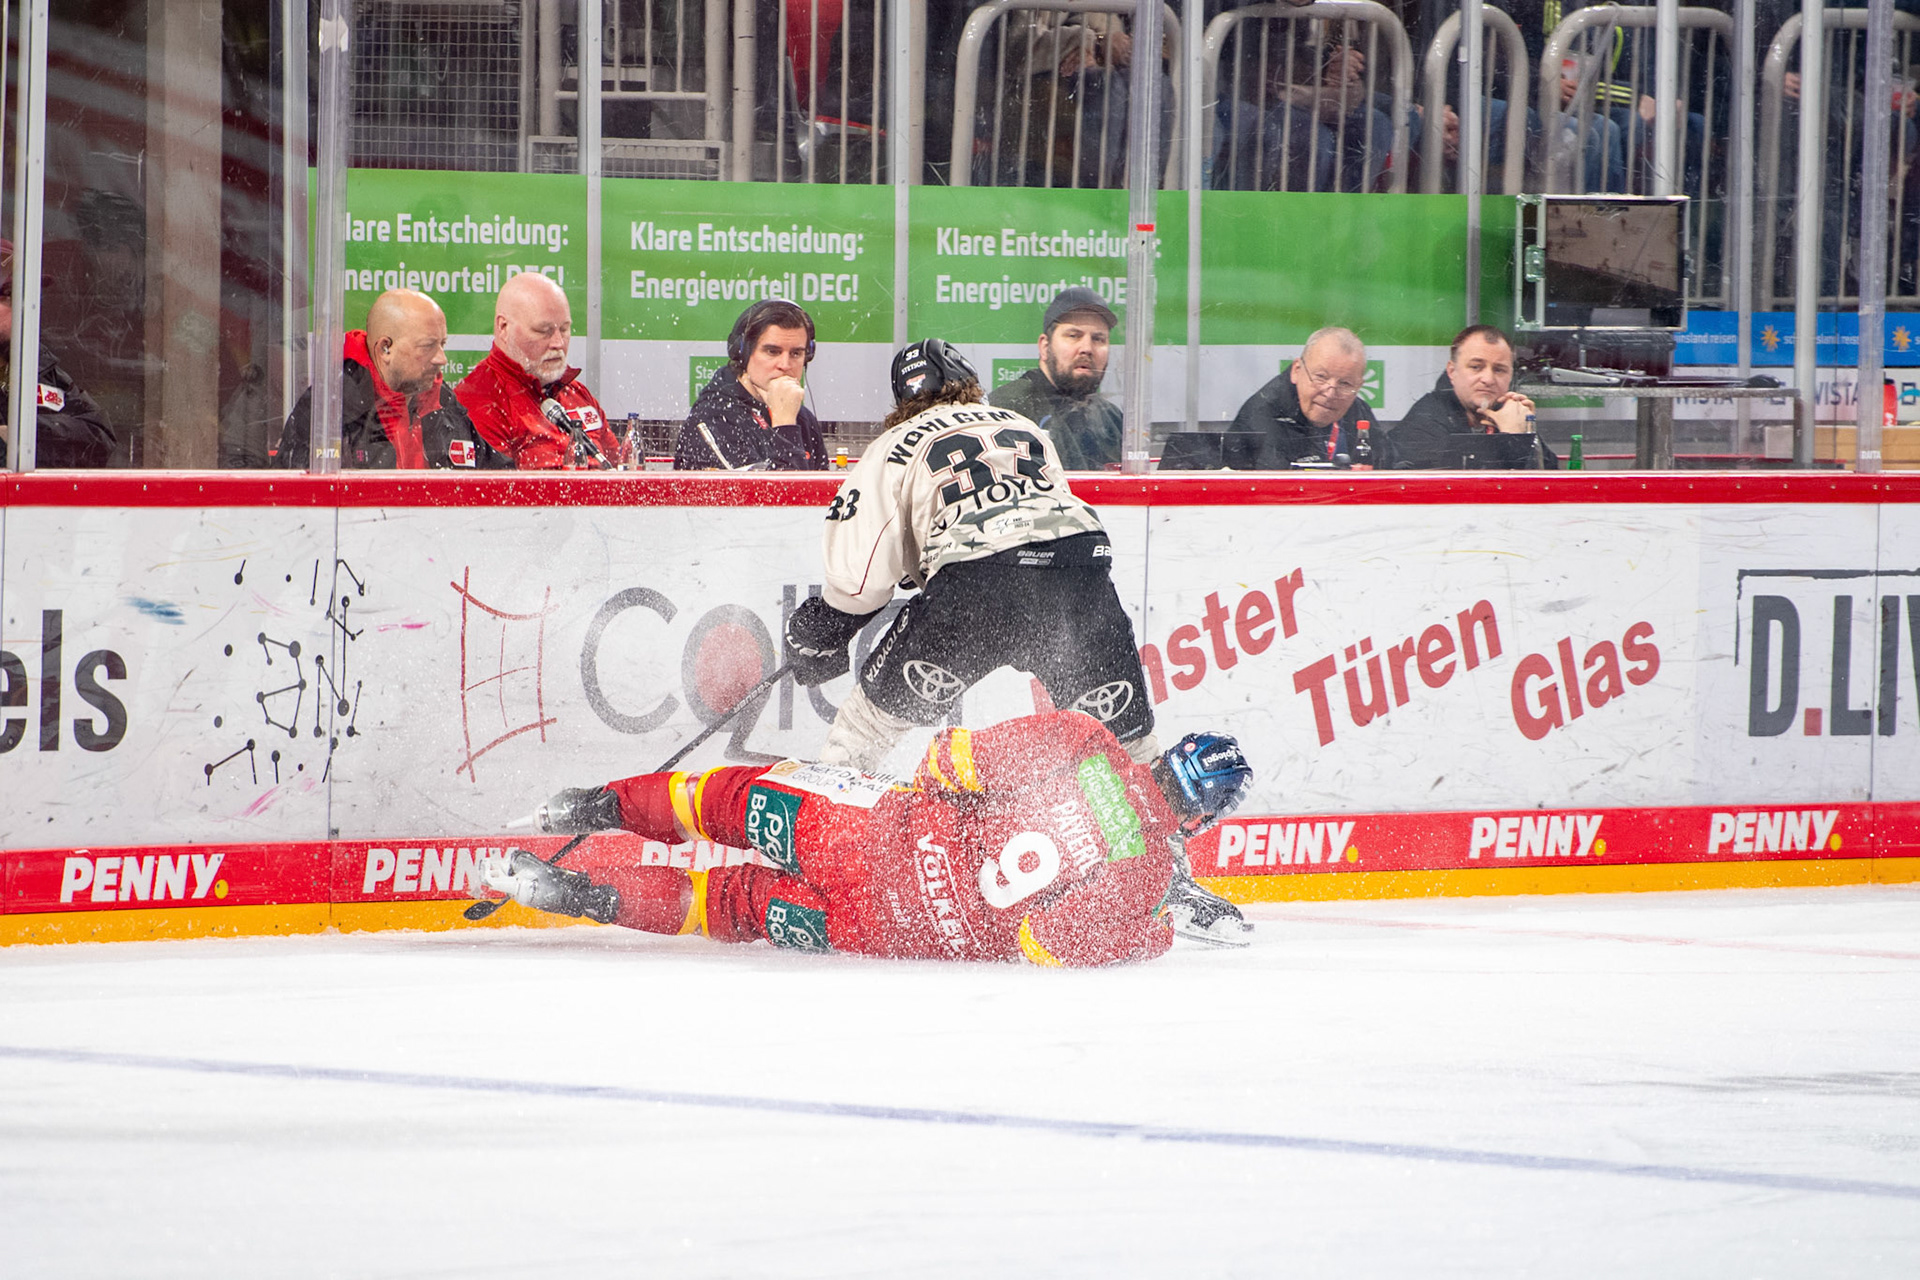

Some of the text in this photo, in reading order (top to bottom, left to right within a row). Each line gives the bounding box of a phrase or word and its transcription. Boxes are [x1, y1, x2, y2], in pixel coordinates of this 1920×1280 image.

[345, 212, 569, 253] lare Entscheidung:
[631, 221, 864, 261] Klare Entscheidung:
[936, 227, 996, 256] Klare
[345, 262, 499, 293] nergievorteil
[631, 270, 859, 307] Energievorteil DEG!
[901, 360, 928, 375] STETSON
[905, 349, 920, 362] 33
[887, 410, 1017, 467] WOHLGEM
[924, 427, 1050, 508] 33
[825, 488, 861, 522] 33
[965, 474, 1054, 510] TOYO
[865, 631, 898, 683] TOYOTA
[1292, 598, 1504, 748] Türen
[1510, 620, 1661, 741] Glas
[1051, 800, 1102, 878] PAYERL
